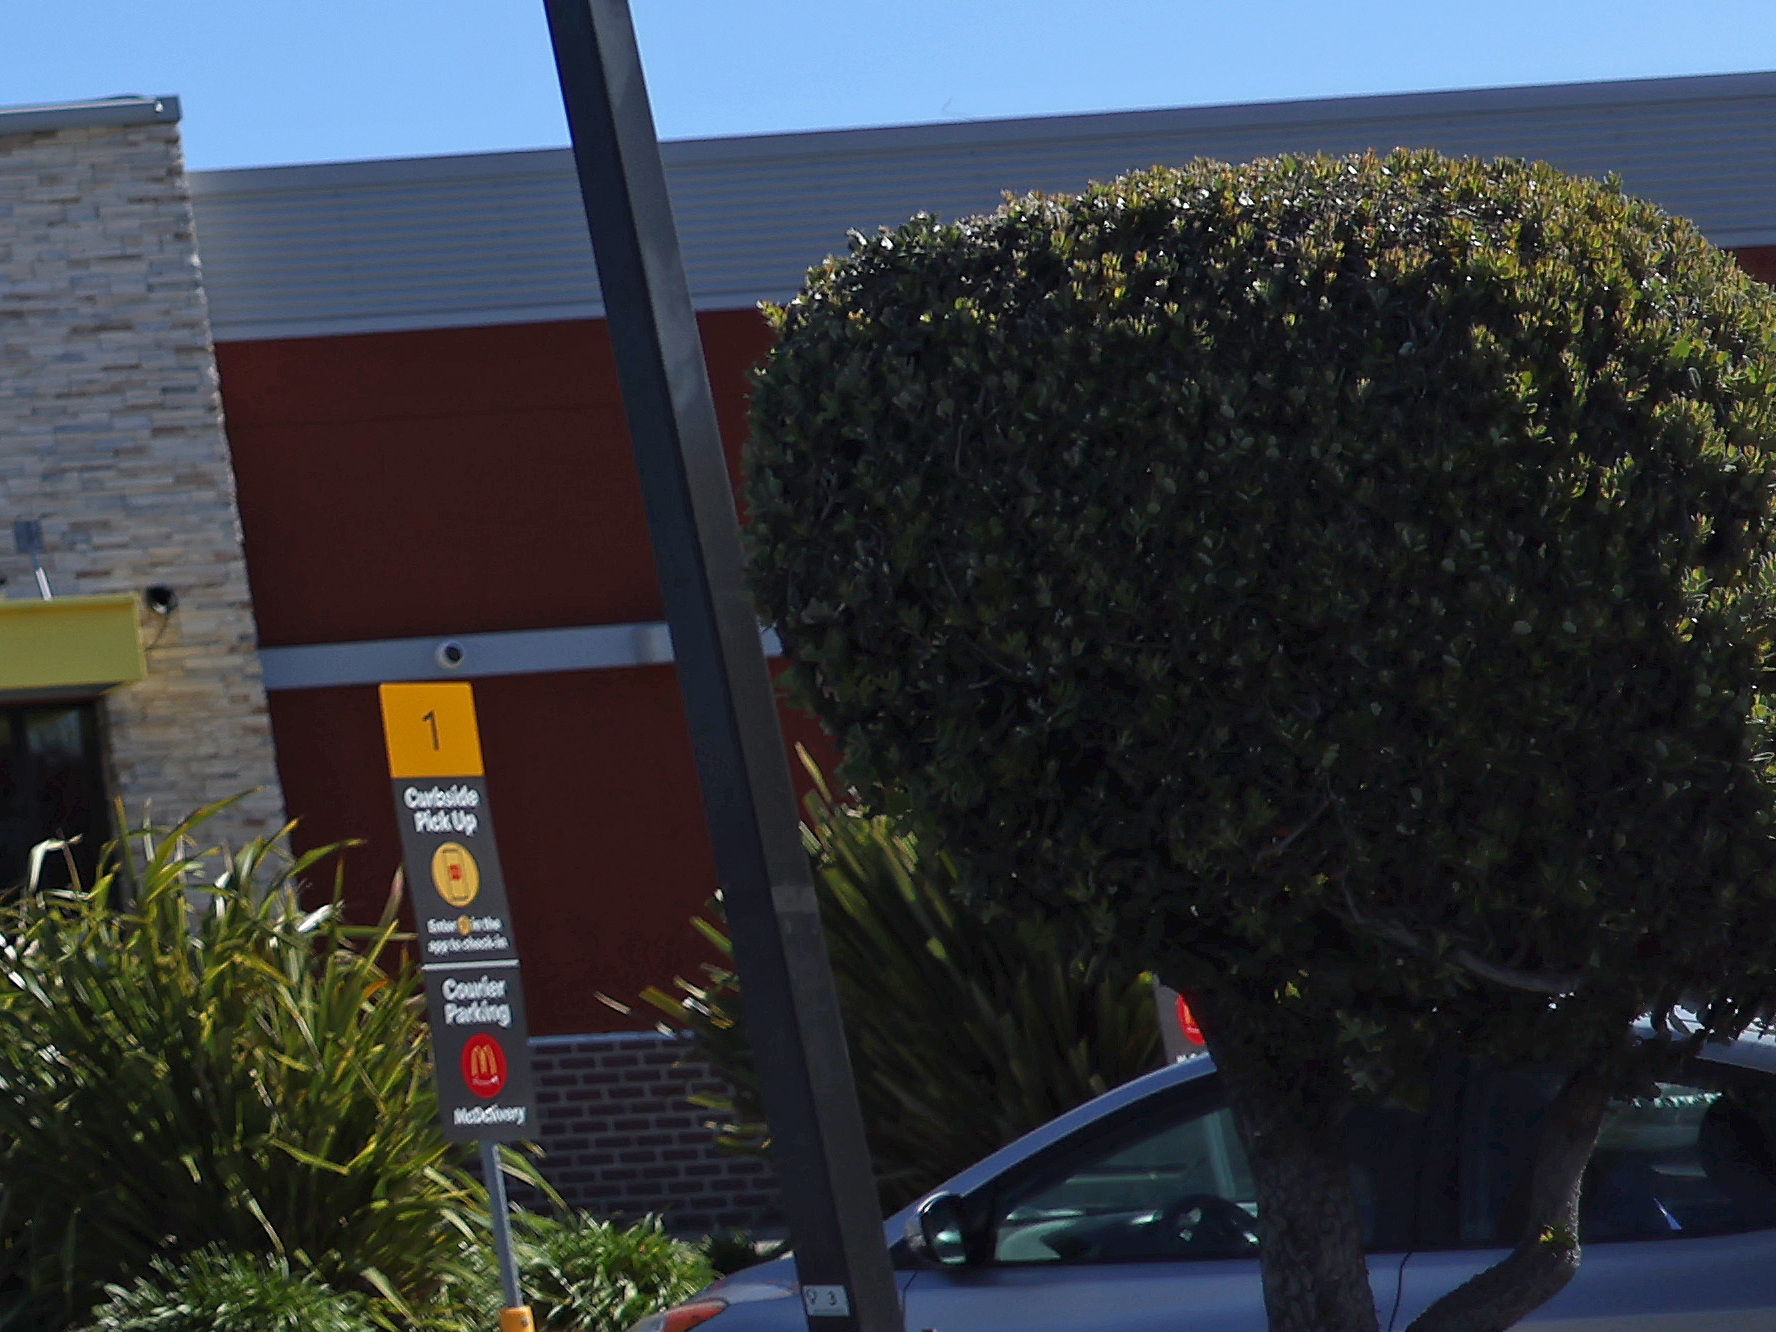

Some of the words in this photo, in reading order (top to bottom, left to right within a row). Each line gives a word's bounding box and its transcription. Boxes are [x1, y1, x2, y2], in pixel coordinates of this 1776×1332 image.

[422, 709, 441, 752] 1
[442, 974, 508, 1002] Courier
[444, 999, 514, 1029] Parking
